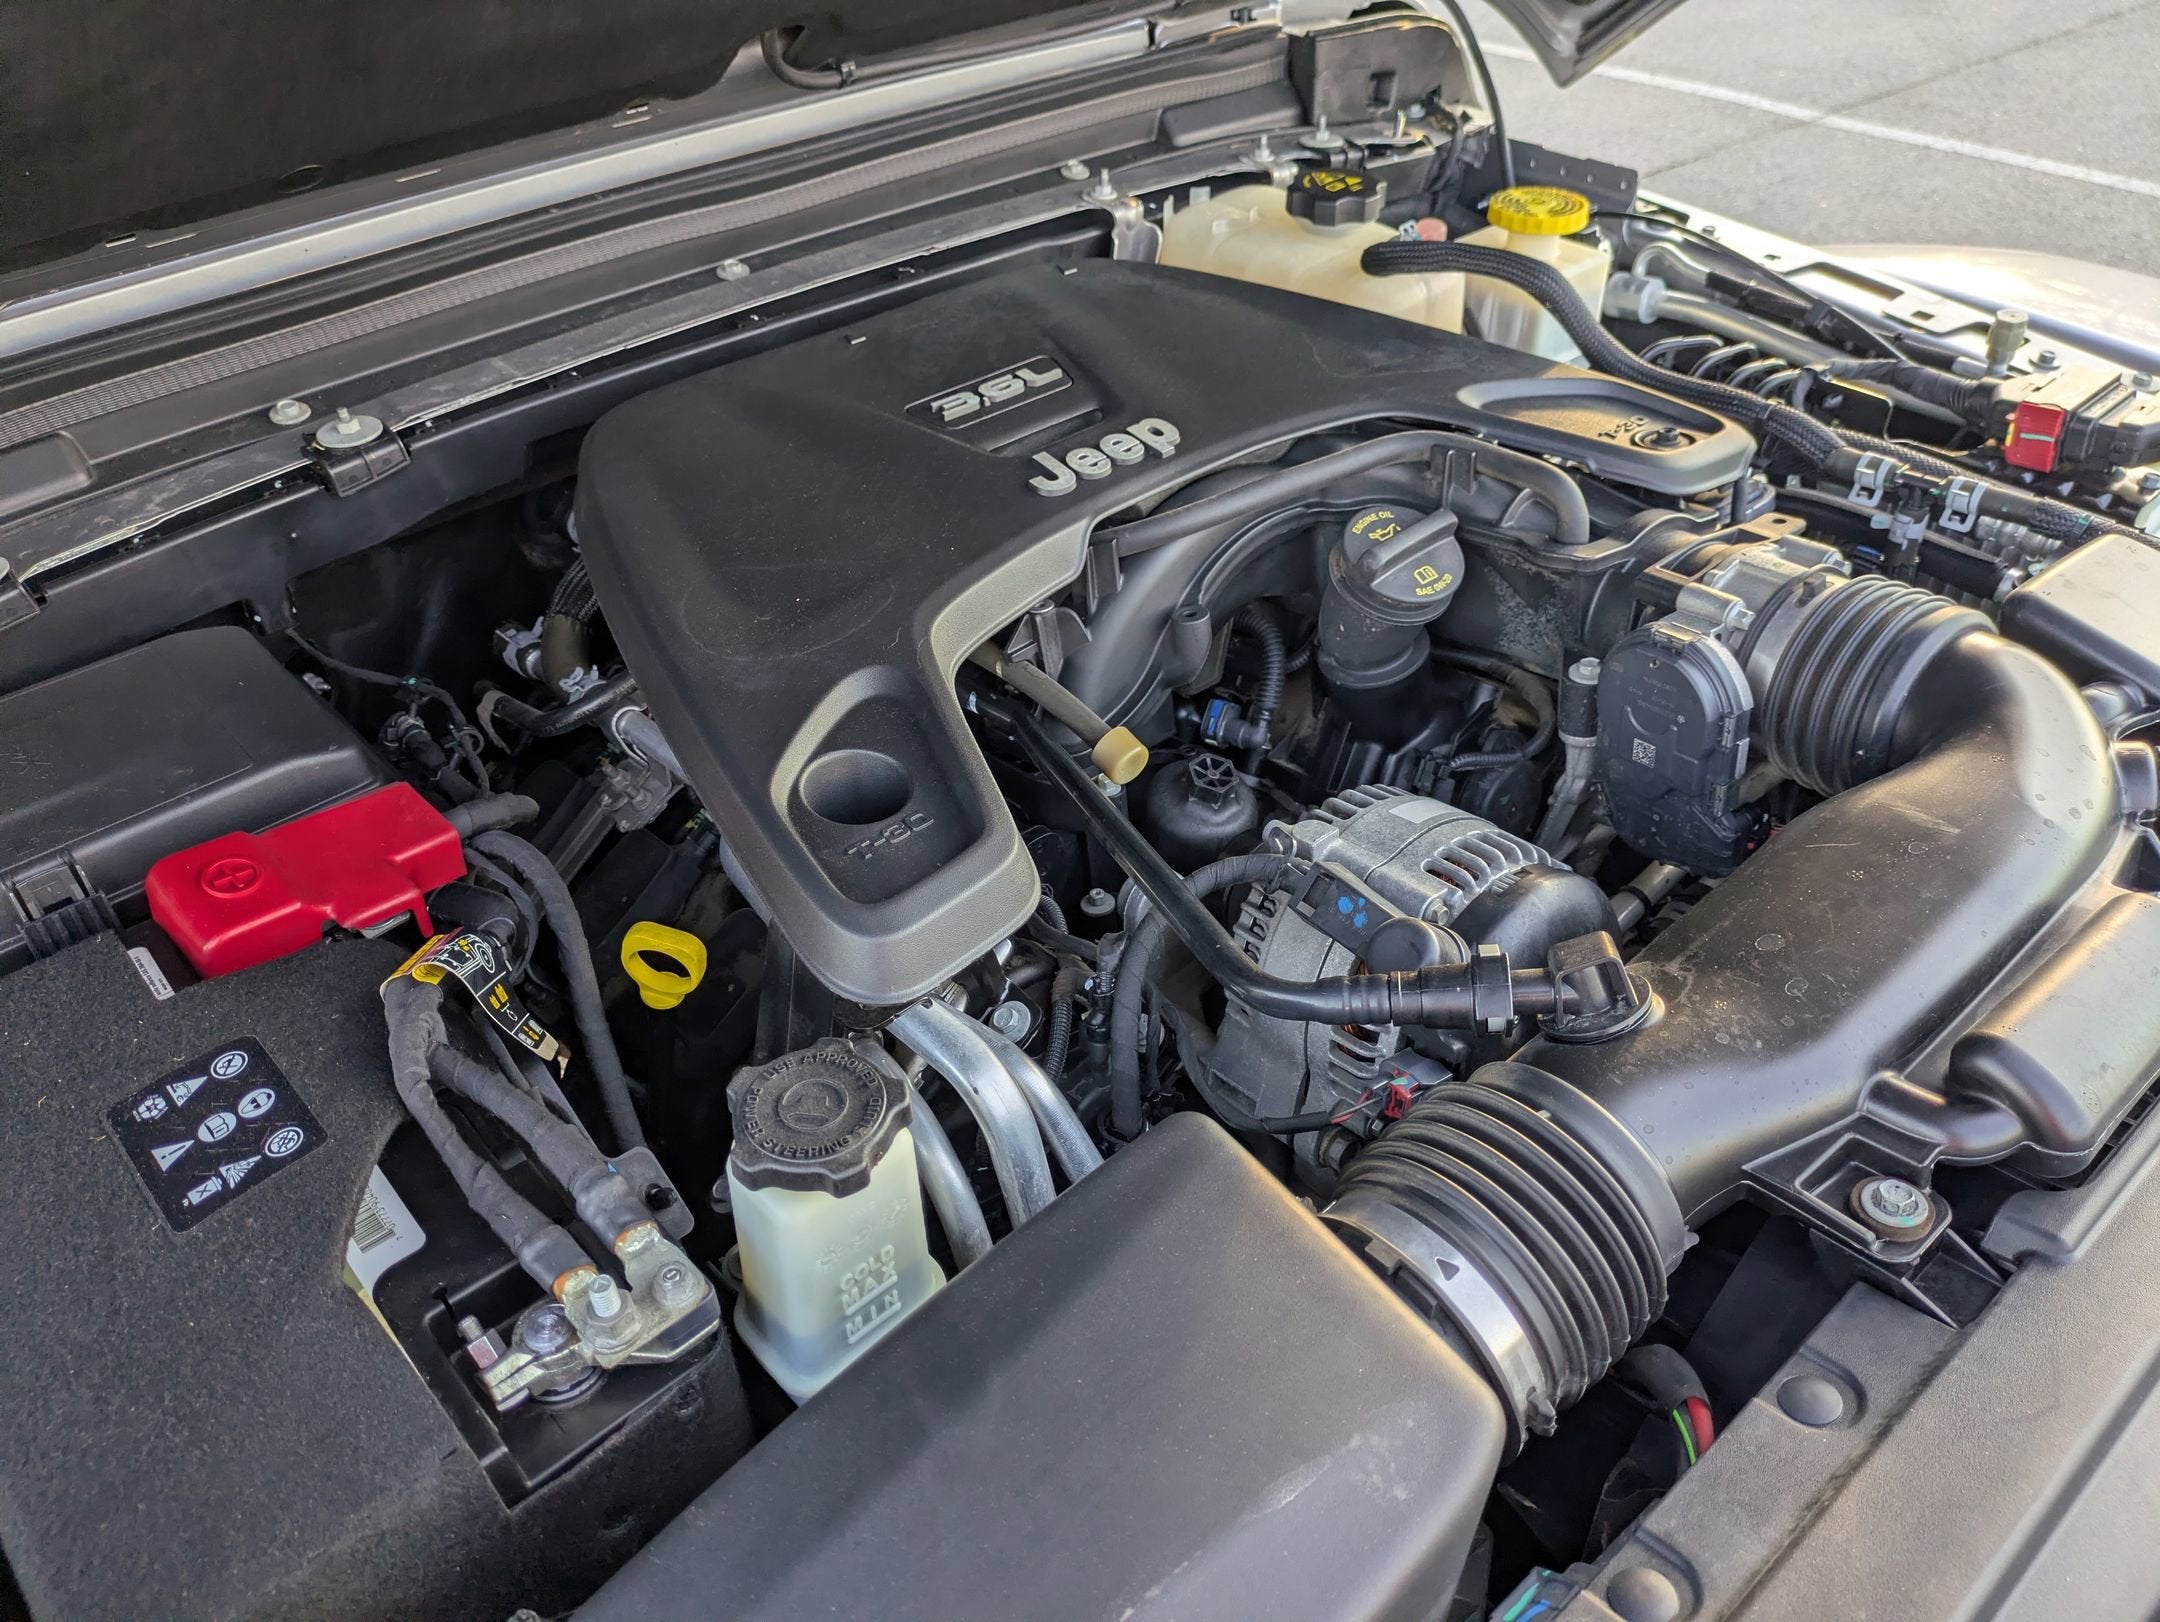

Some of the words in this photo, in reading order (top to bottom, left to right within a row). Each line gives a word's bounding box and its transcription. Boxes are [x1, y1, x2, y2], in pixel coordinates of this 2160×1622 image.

[931, 368, 1062, 421] 3.6L
[1028, 418, 1181, 497] Jeep
[1351, 512, 1379, 535] ENGINE
[1378, 511, 1395, 519] OIL
[1415, 586, 1435, 596] SAE
[845, 811, 935, 860] T-30
[764, 1058, 796, 1079] USE
[803, 1052, 878, 1087] APPROVED
[745, 1087, 765, 1140] POWER
[763, 1134, 852, 1158] STEERING
[855, 1097, 882, 1137] FLUID
[840, 1244, 895, 1292] COLD
[842, 1261, 898, 1314] MAX
[846, 1289, 899, 1338] MIN
